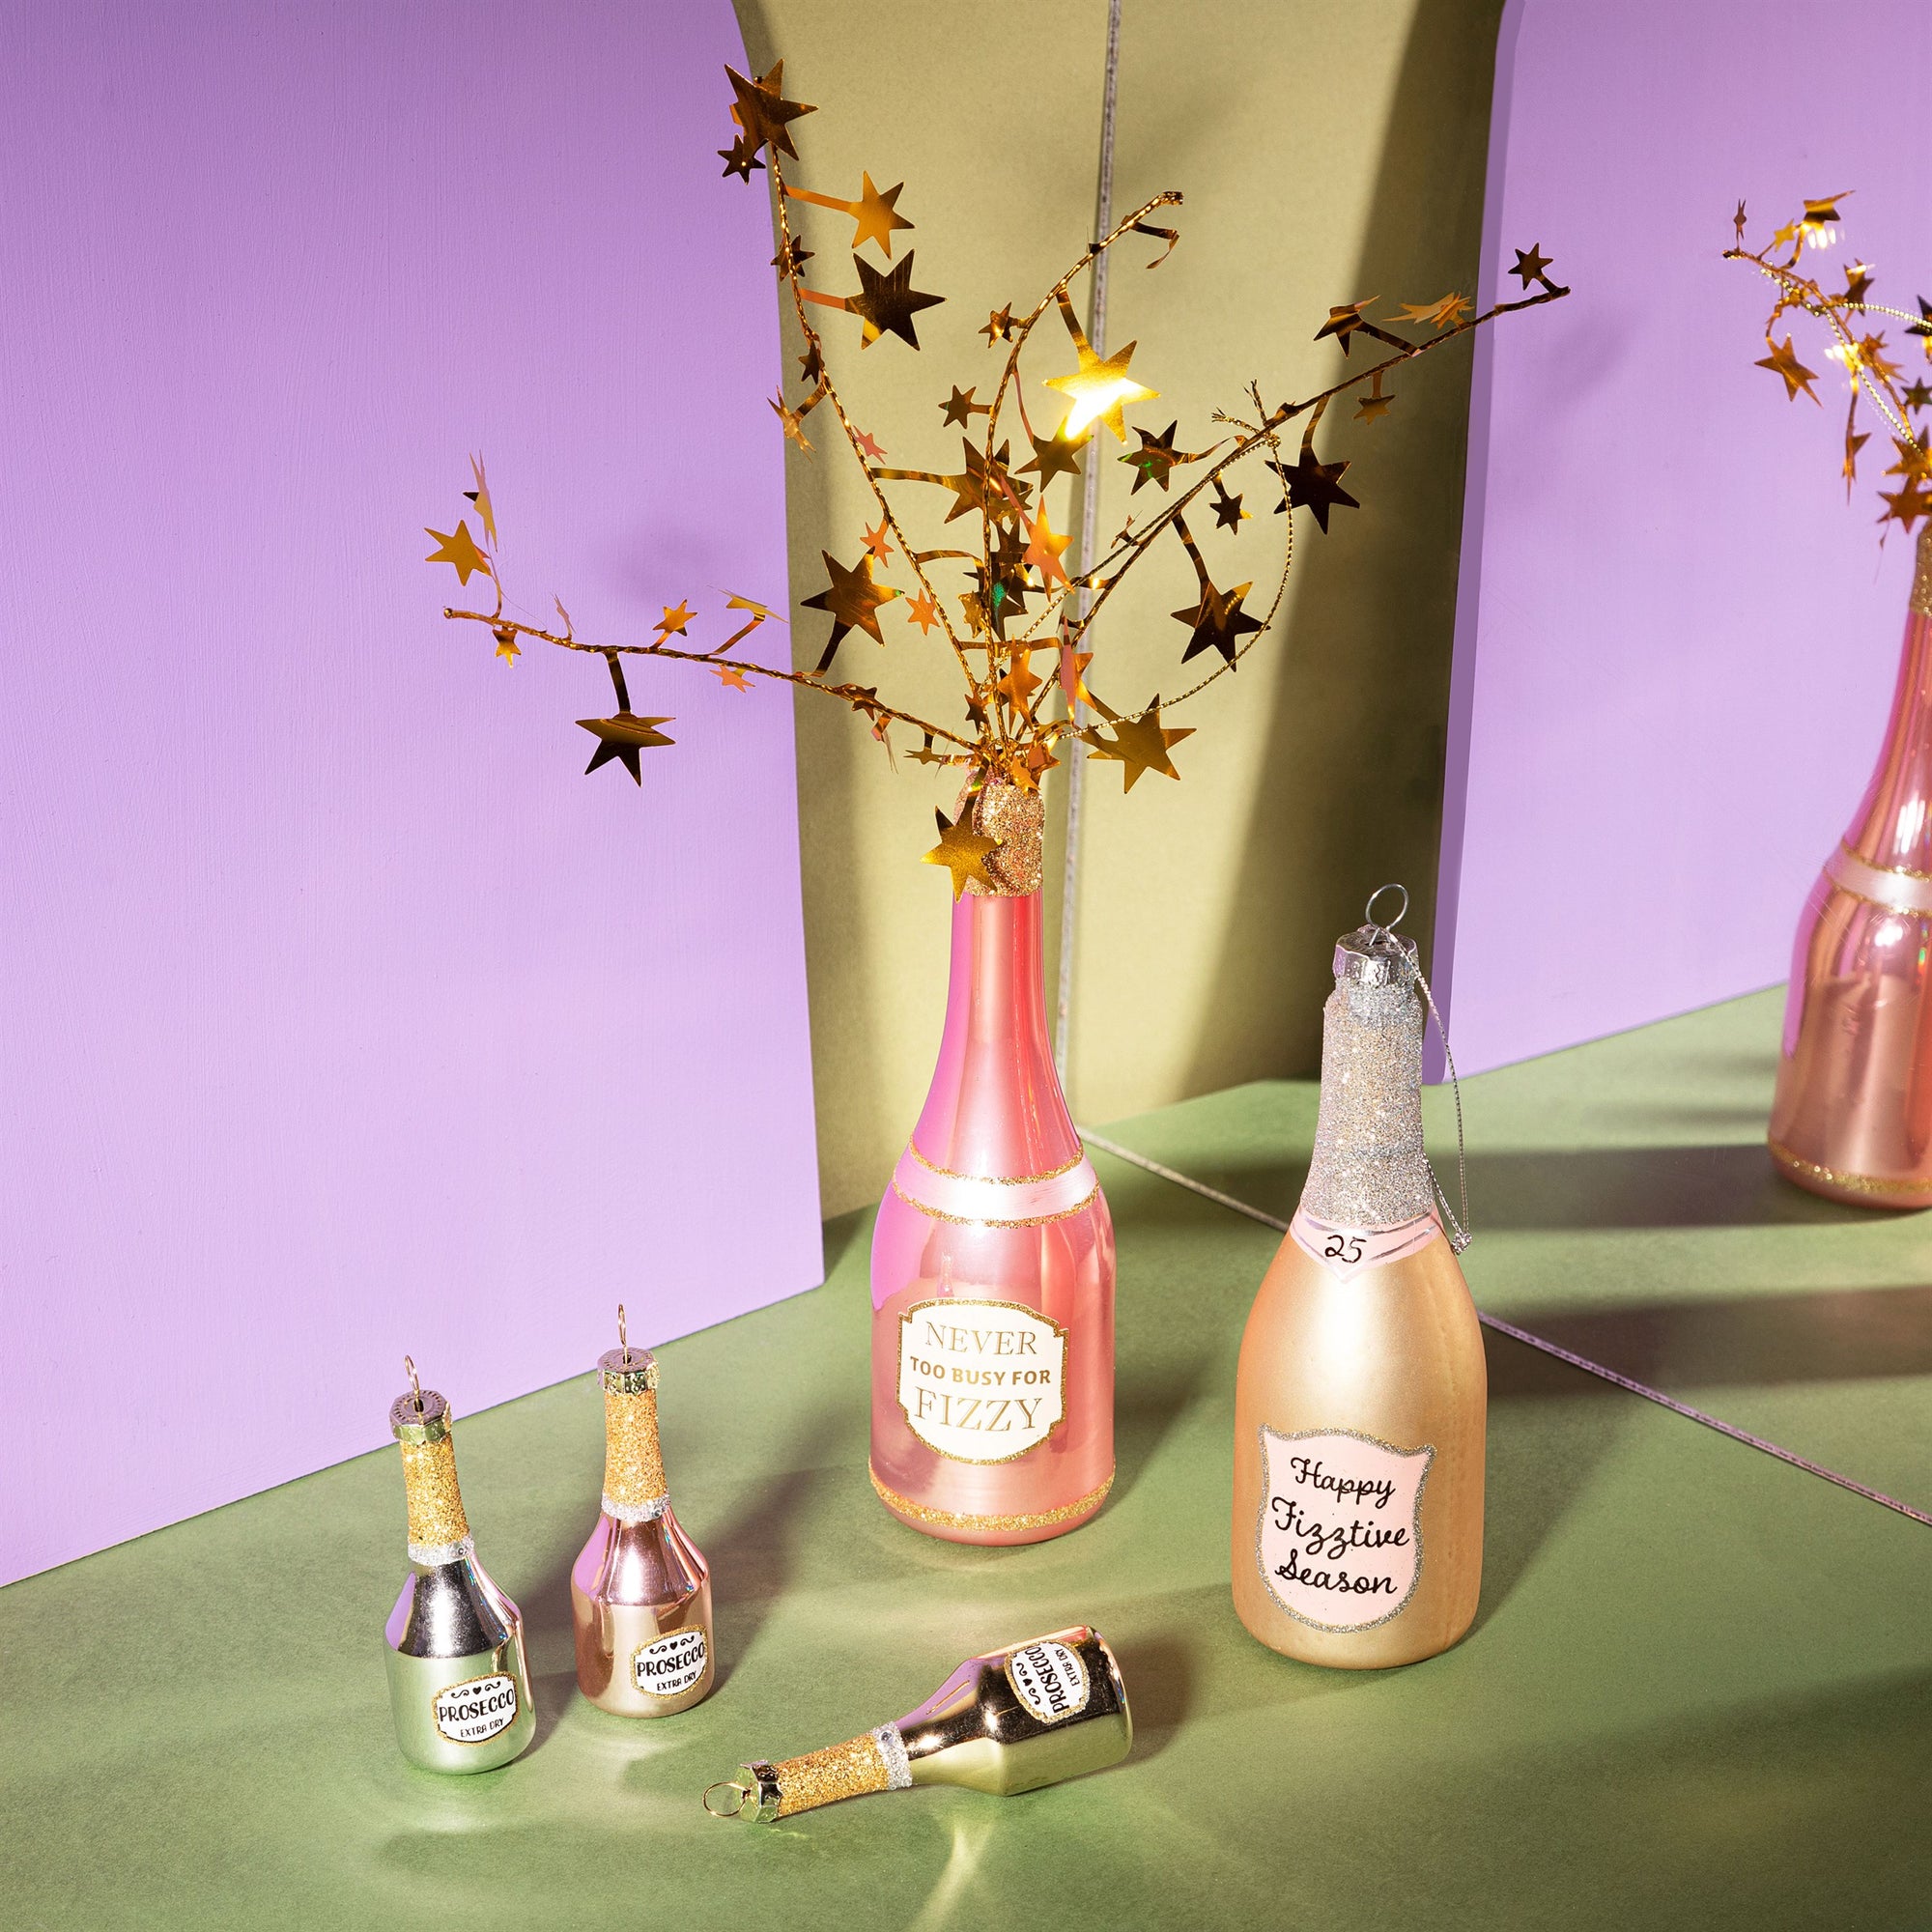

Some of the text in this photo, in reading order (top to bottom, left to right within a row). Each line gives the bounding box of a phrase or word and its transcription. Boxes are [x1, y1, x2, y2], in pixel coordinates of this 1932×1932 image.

[1324, 1235, 1367, 1264] 25
[924, 1321, 1037, 1355] NEVER
[910, 1356, 1051, 1385] TOO BUSY FOR
[914, 1386, 1042, 1432] FIZZY
[1290, 1457, 1396, 1510] Happy
[1271, 1496, 1409, 1560] Fizztive
[1274, 1548, 1398, 1595] Season
[637, 1641, 705, 1677] PROSECCO
[1062, 1661, 1081, 1687] EXTRA
[656, 1670, 697, 1691] EXTRA DRY
[1024, 1646, 1070, 1714] PROSECCO
[439, 1689, 515, 1722] PROSECCO
[460, 1724, 488, 1738] EXTRA
